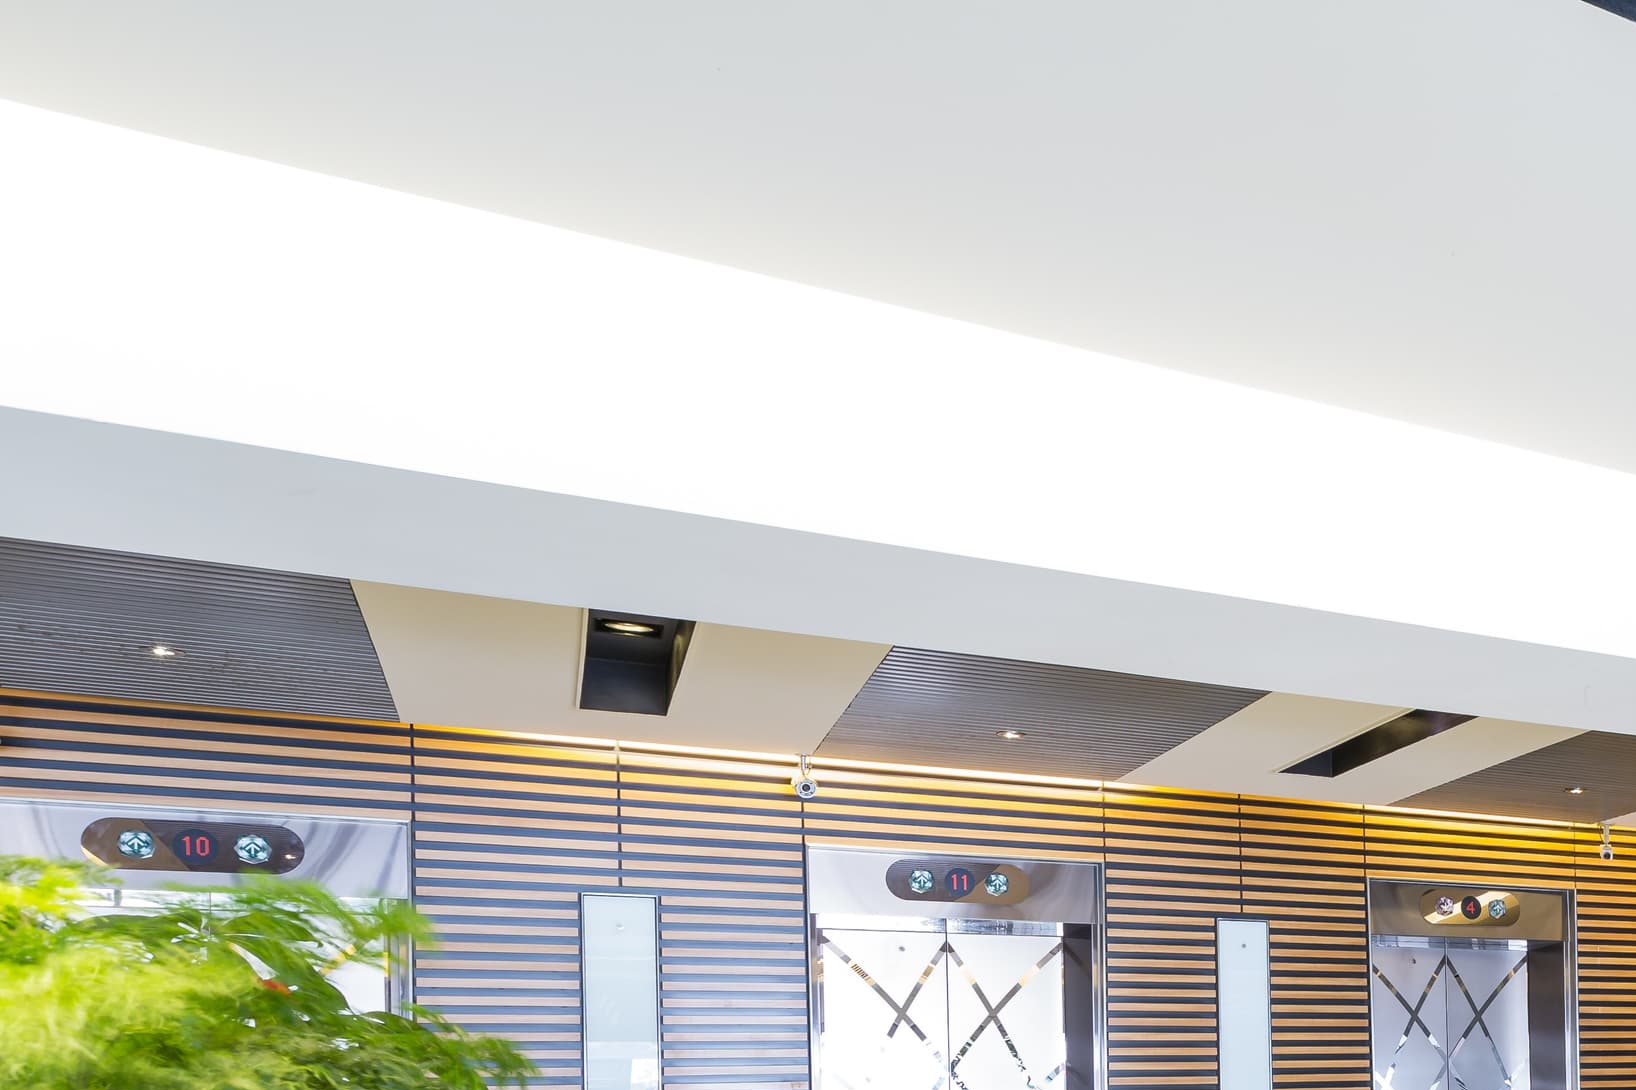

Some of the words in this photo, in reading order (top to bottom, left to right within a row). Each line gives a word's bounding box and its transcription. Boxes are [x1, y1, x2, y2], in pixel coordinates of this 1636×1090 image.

[181, 836, 210, 856] 10
[951, 874, 968, 890] 11
[1466, 901, 1476, 914] 4
